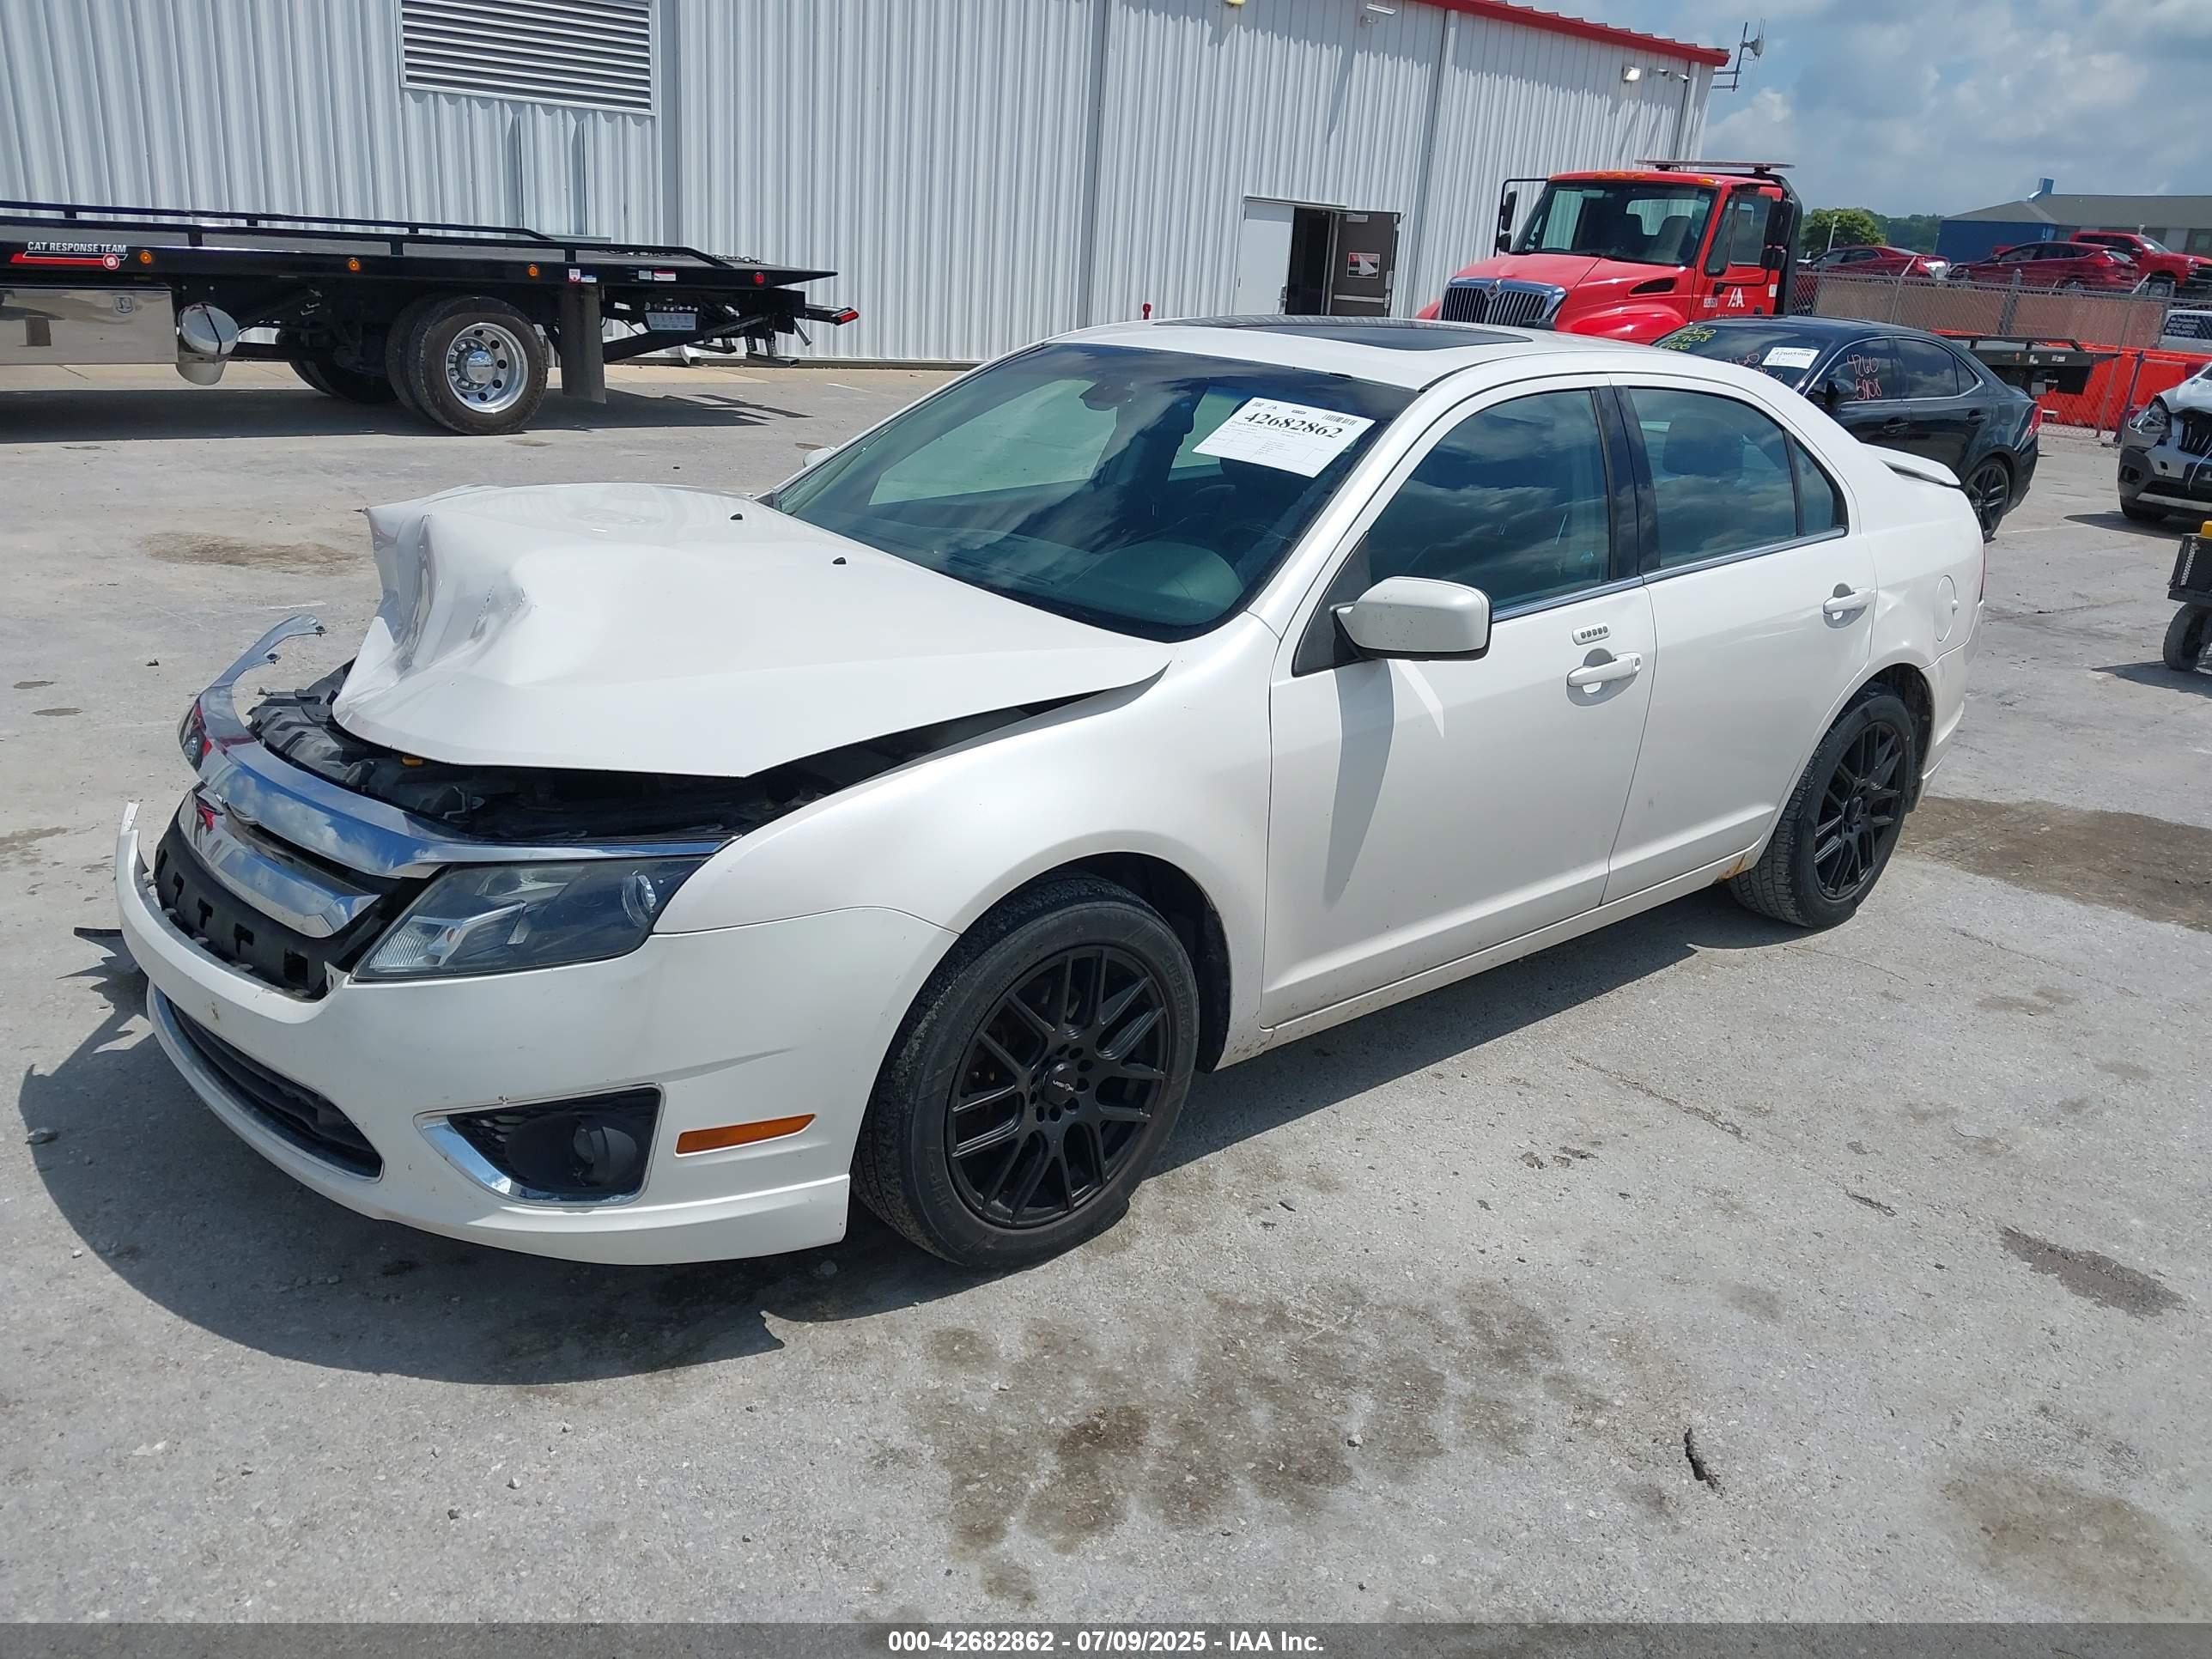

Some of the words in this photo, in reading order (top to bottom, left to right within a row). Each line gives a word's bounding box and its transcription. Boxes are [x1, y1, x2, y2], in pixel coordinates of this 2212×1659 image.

[27, 241, 47, 251] CAT
[49, 242, 98, 252] RESPONSE
[100, 244, 127, 253] TEAM
[1847, 354, 1880, 377] 4260
[1244, 412, 1343, 439] 42682862
